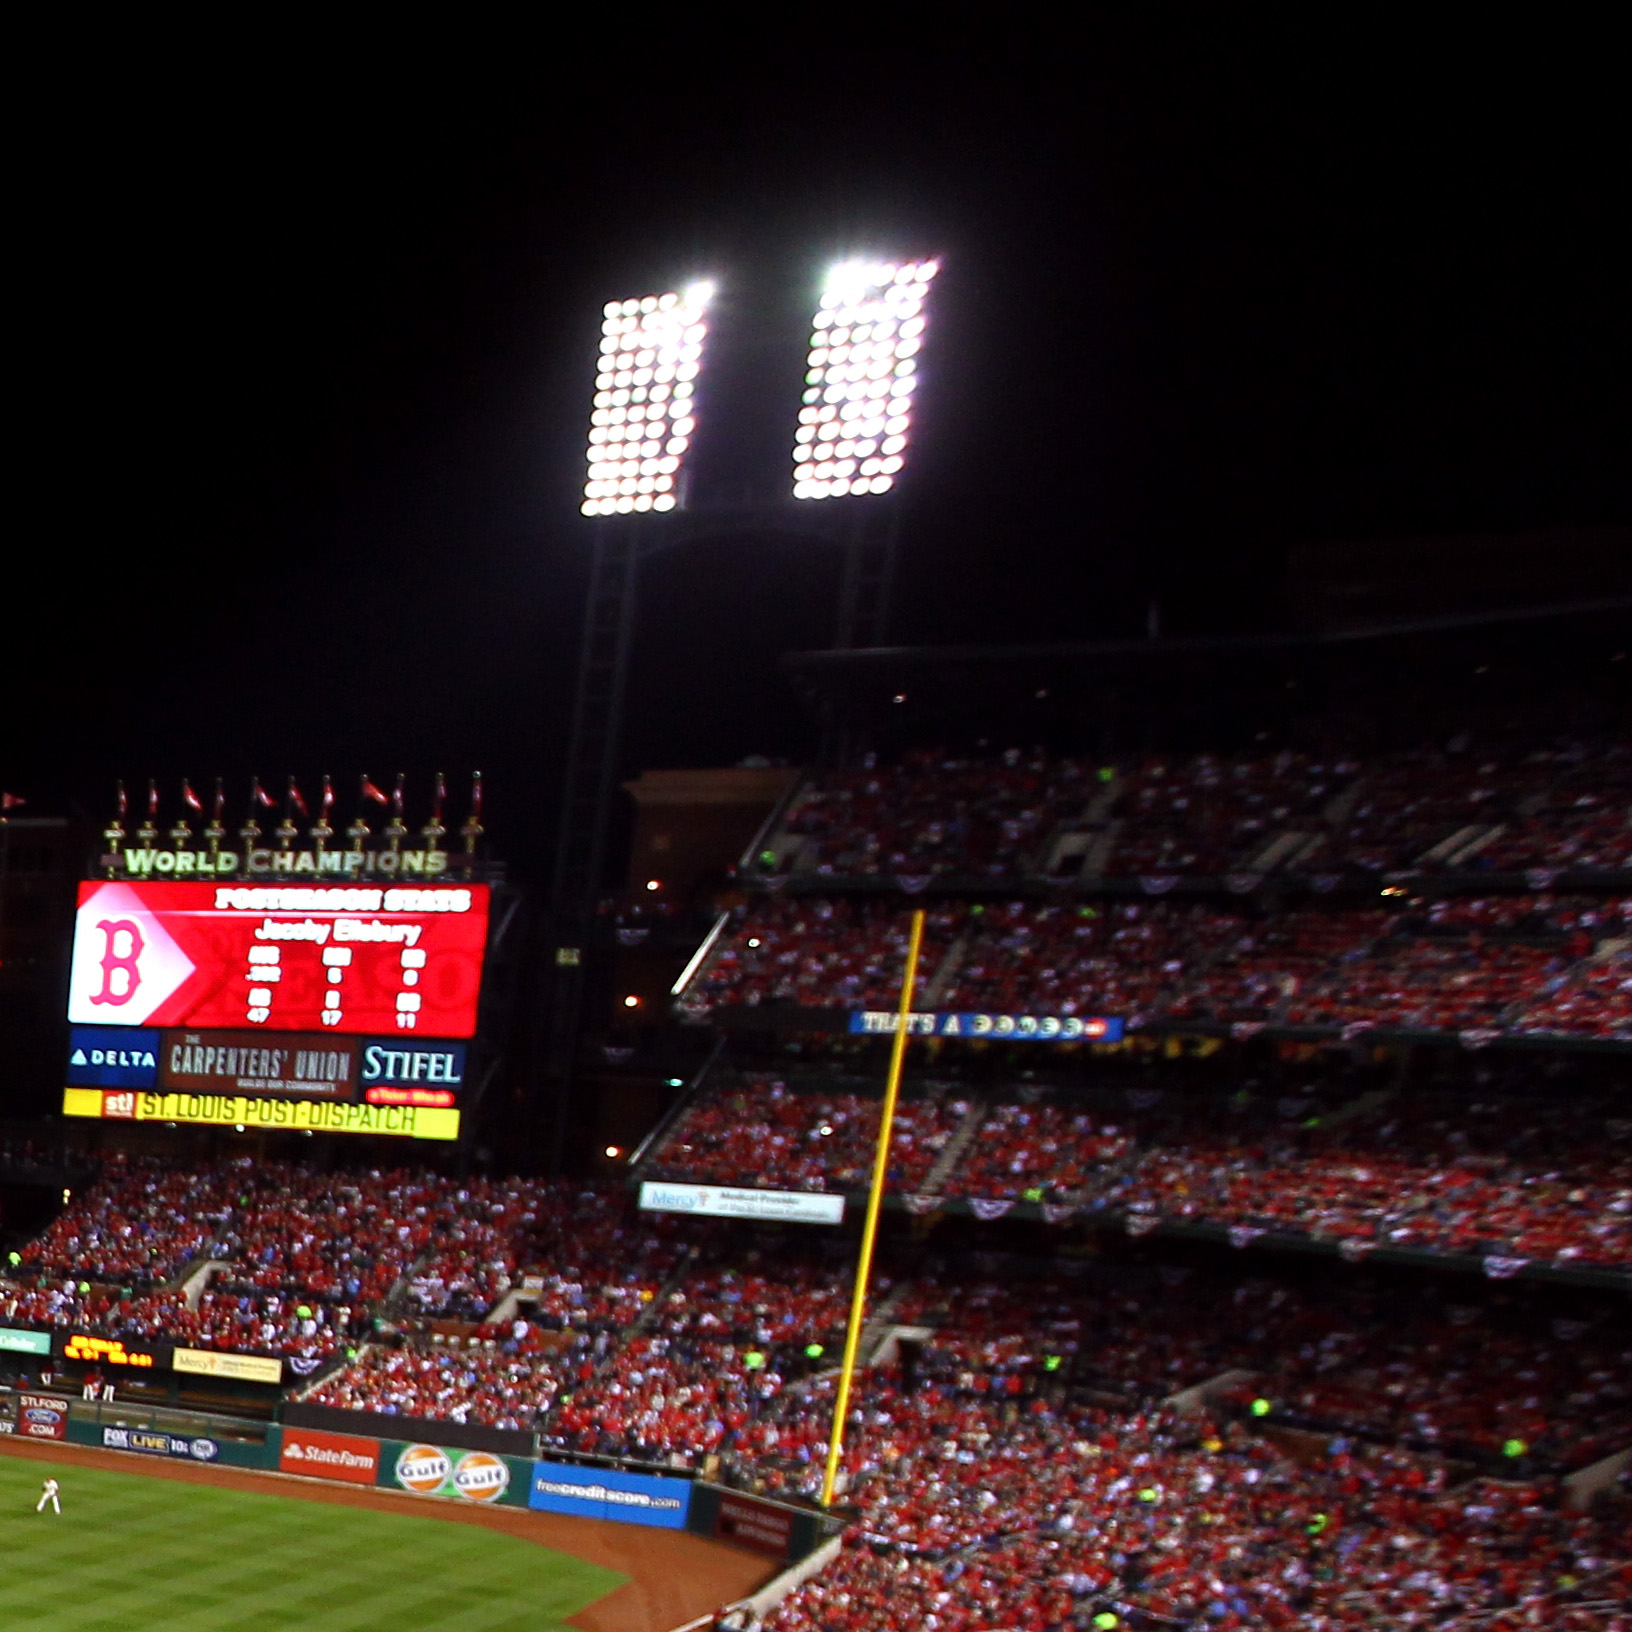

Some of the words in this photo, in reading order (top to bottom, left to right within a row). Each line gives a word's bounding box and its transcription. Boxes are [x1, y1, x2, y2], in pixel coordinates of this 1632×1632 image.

[125, 848, 236, 873] WORLD
[247, 848, 448, 874] CHAMPIONS
[215, 888, 382, 911] POSTSEASON
[384, 889, 471, 912] STATS
[942, 1015, 961, 1036] A
[185, 1034, 201, 1044] THE
[91, 1049, 155, 1068] DELTA
[170, 1044, 288, 1078] CARPENTERS'
[294, 1050, 351, 1081] UNION
[362, 1045, 461, 1083] STIFEL
[105, 1092, 133, 1111] stl
[143, 1096, 171, 1117] ST.
[175, 1096, 235, 1120] LOUIS
[244, 1097, 416, 1132] POST-DISPATCH
[652, 1189, 699, 1210] Mercy
[180, 1355, 208, 1371] Mercy
[28, 1423, 55, 1436] .COM
[104, 1427, 128, 1442] FOX
[132, 1435, 167, 1449] LIVE
[399, 1460, 446, 1478] Gulf
[455, 1469, 502, 1487] Gulf
[536, 1479, 681, 1509] freecreditscore.com
